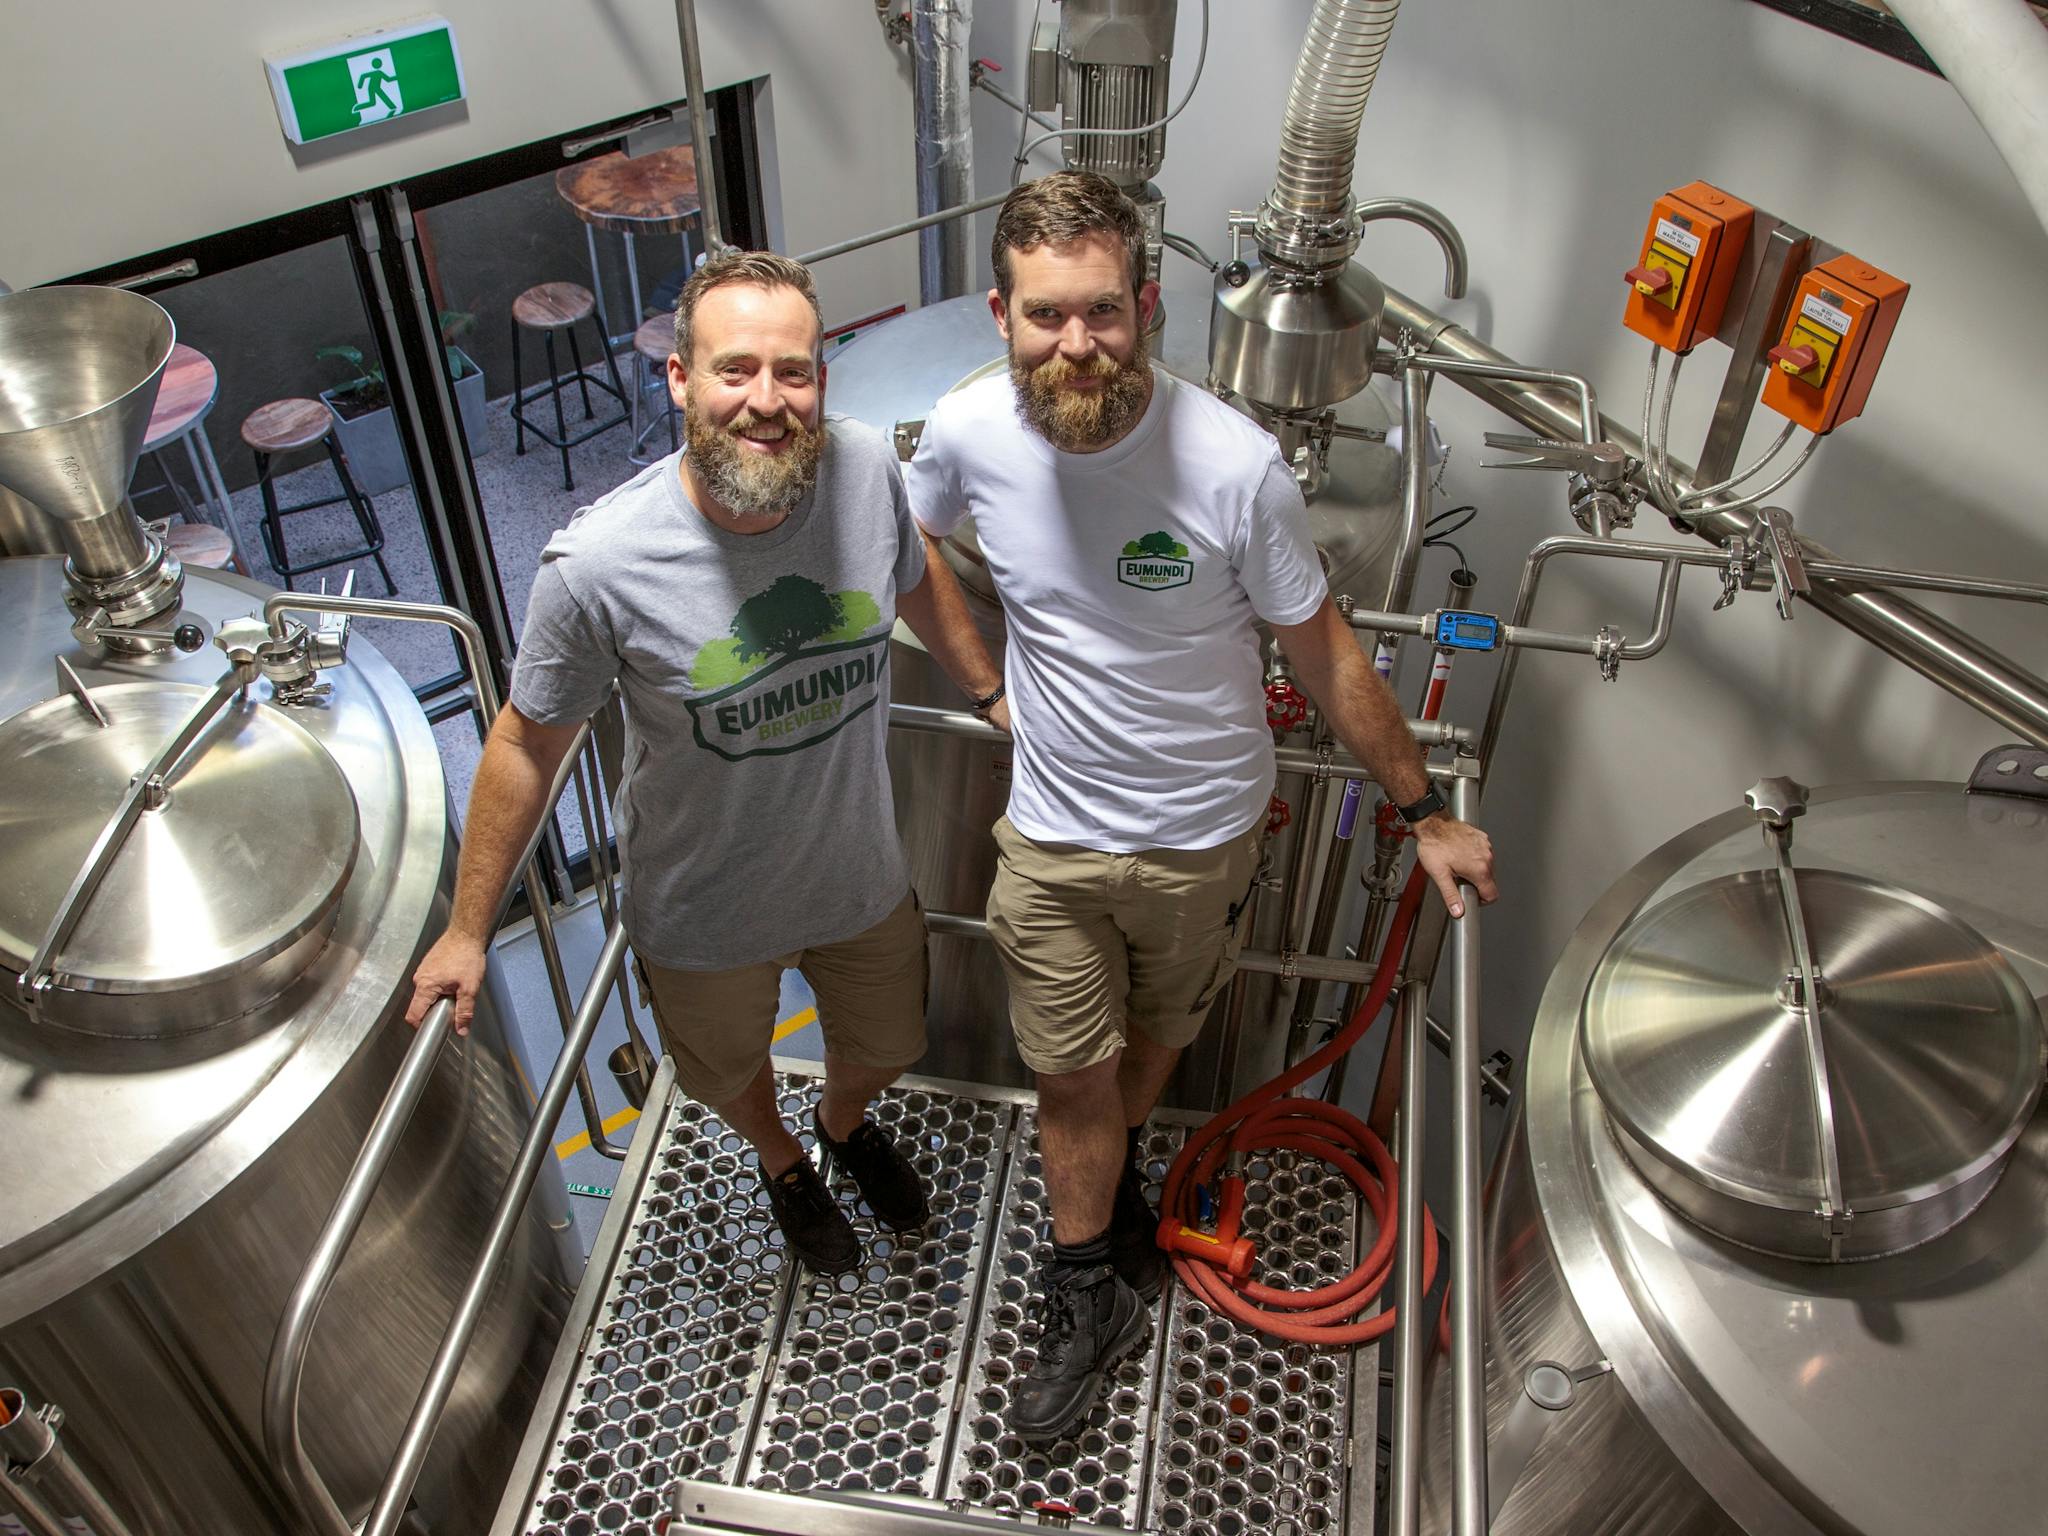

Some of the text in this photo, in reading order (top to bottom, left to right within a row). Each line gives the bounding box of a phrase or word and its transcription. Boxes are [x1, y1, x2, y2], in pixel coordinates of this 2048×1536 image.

[1126, 562, 1184, 577] EUMUNDI
[1139, 576, 1169, 584] BREWERY
[715, 652, 875, 735] EUMUNDI
[758, 698, 844, 740] BREWERY
